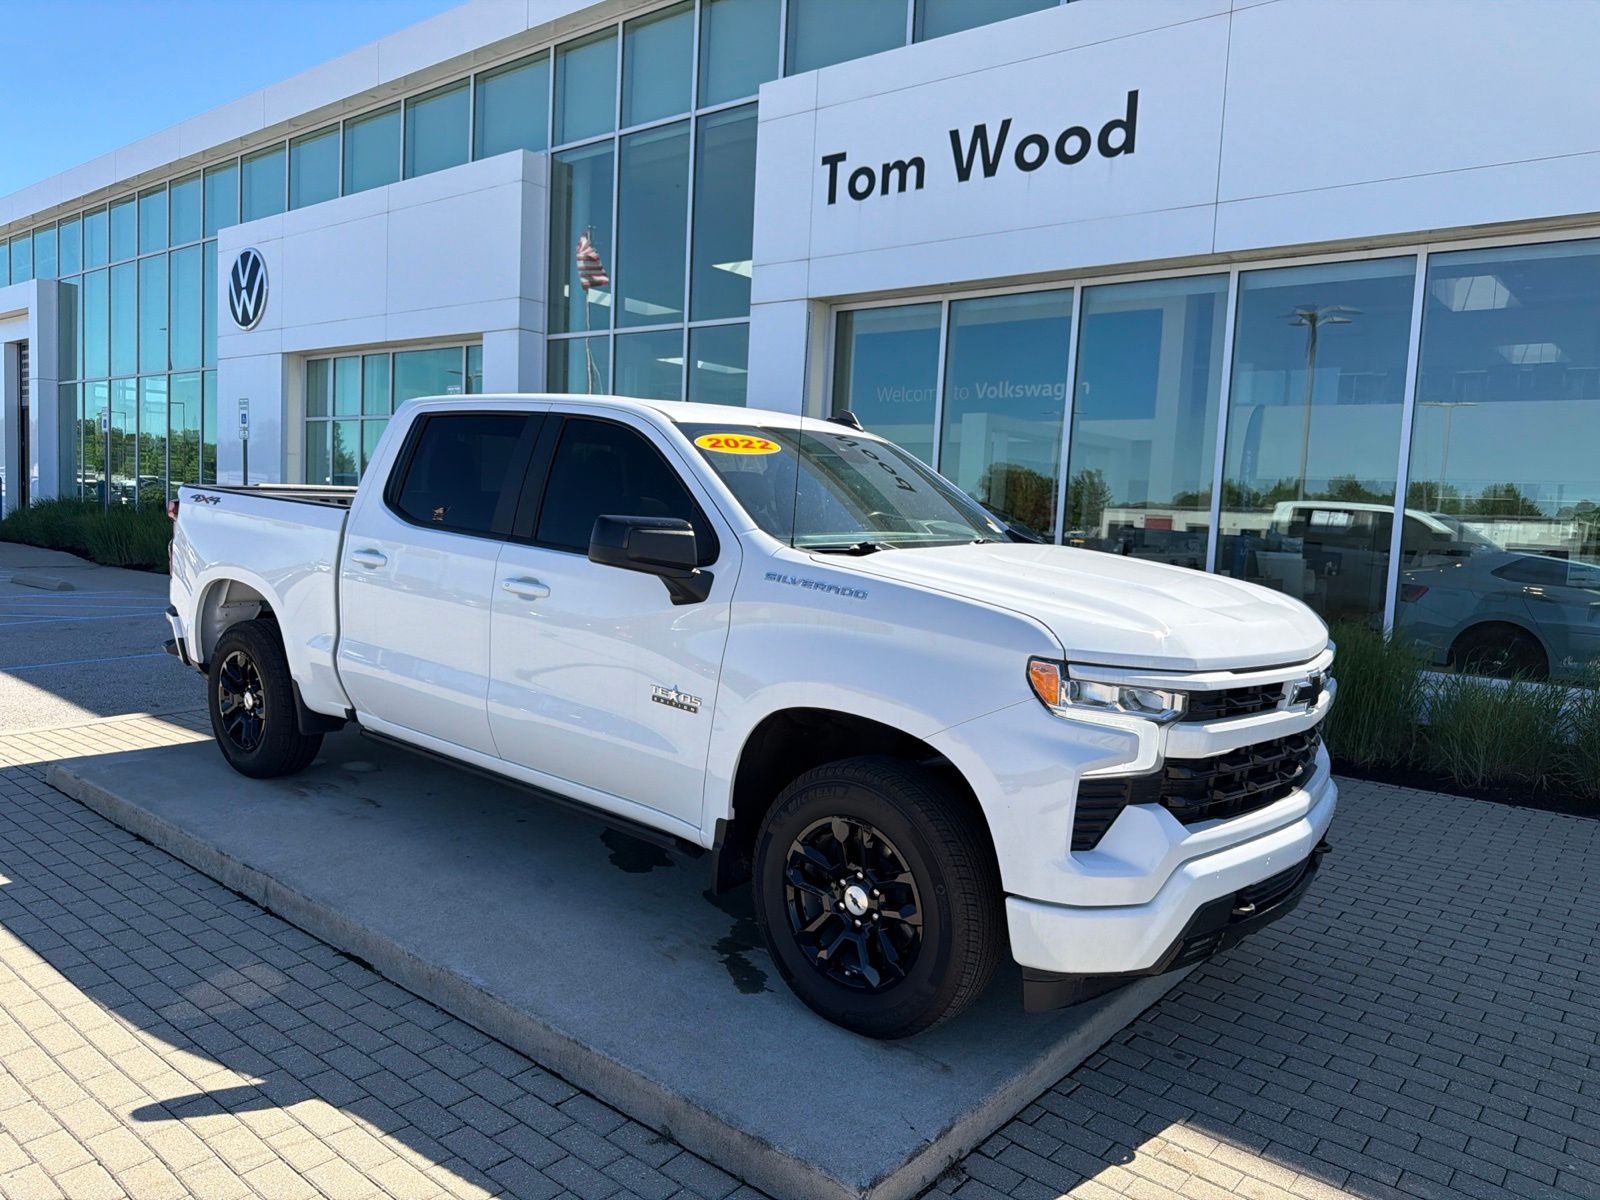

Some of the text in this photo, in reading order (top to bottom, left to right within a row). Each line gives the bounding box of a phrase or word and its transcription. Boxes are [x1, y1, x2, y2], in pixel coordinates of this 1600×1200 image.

[821, 88, 1140, 206] Tom Wood
[876, 379, 1090, 403] Welcom to Volkswagn
[706, 437, 773, 450] 2022
[764, 572, 869, 600] SILVERADO
